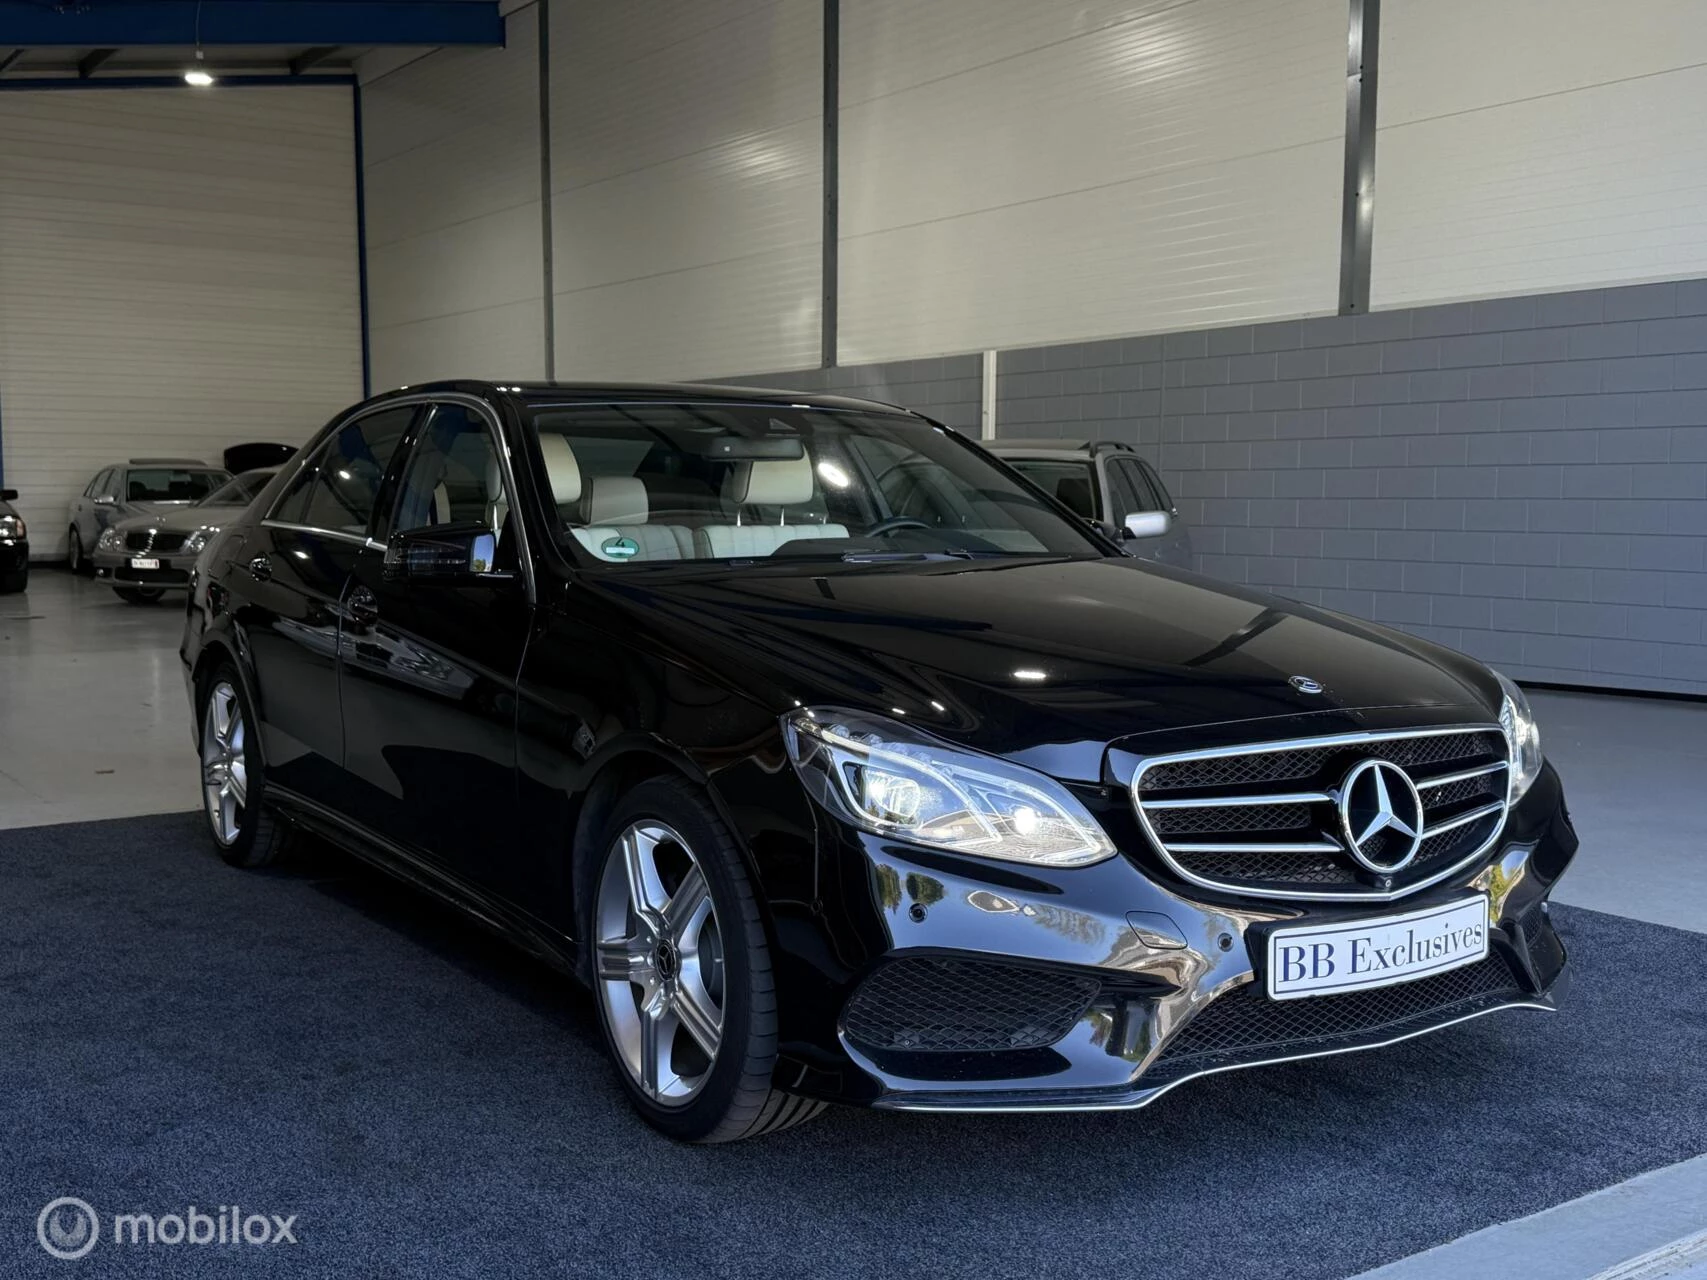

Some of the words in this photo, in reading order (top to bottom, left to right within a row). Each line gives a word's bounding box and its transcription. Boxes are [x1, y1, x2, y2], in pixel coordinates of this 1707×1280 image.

[615, 537, 625, 548] 4
[1278, 942, 1335, 983] BB
[1347, 922, 1483, 975] Exclusives
